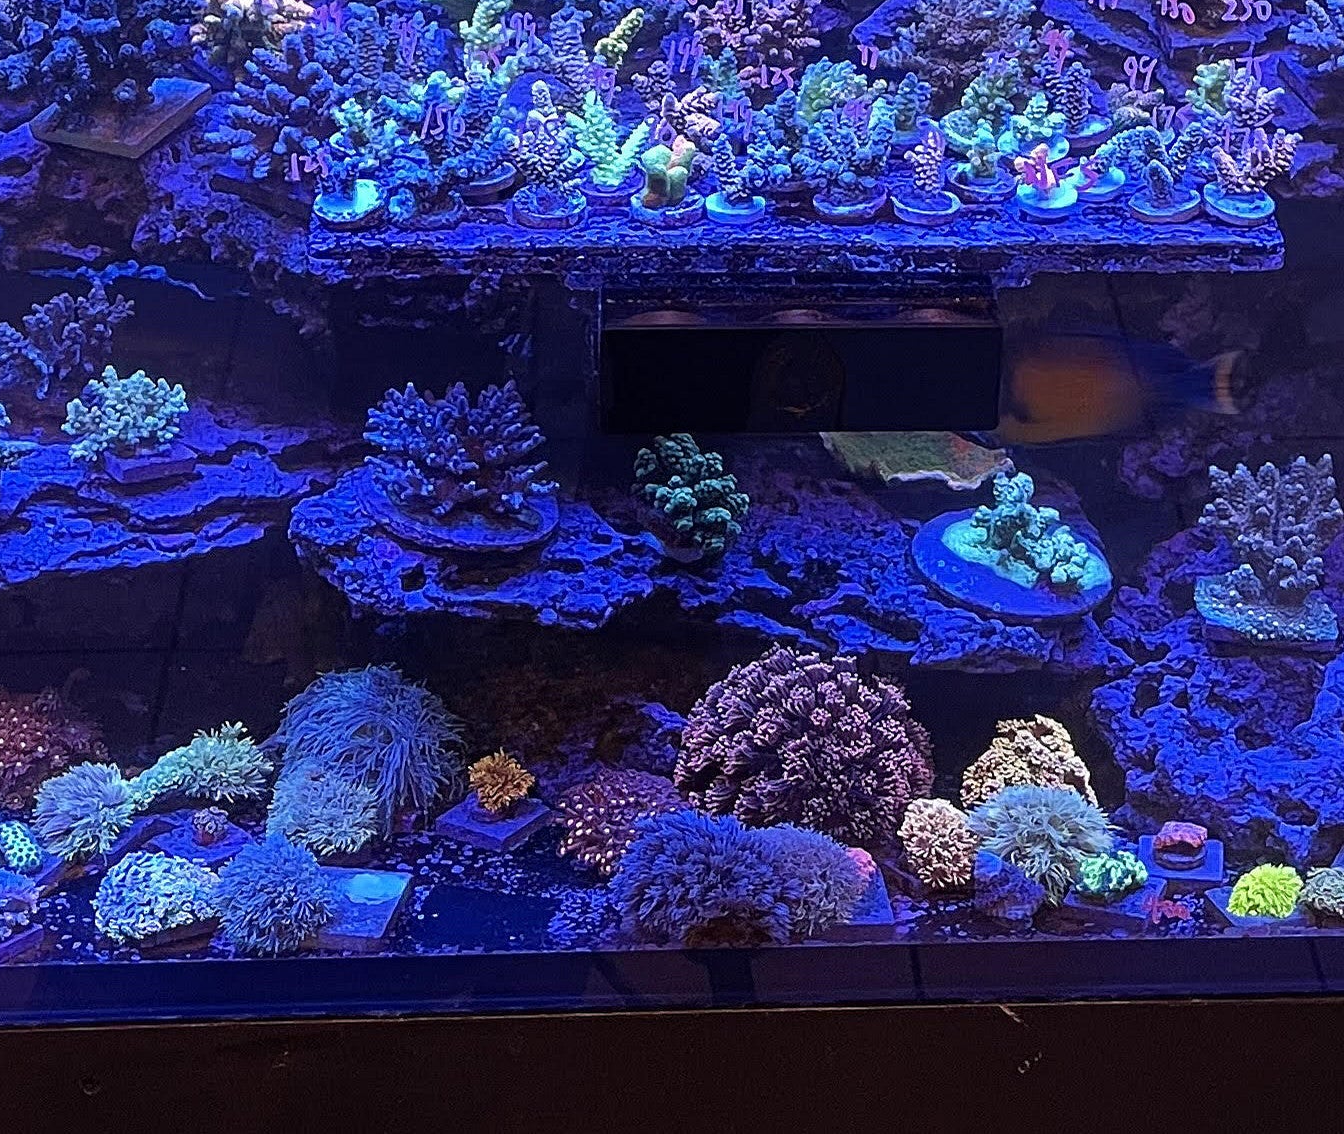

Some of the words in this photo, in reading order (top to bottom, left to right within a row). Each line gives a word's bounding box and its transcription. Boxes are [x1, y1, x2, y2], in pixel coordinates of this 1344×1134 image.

[760, 64, 796, 89] 125
[1123, 55, 1158, 92] 99
[421, 102, 466, 140] 150
